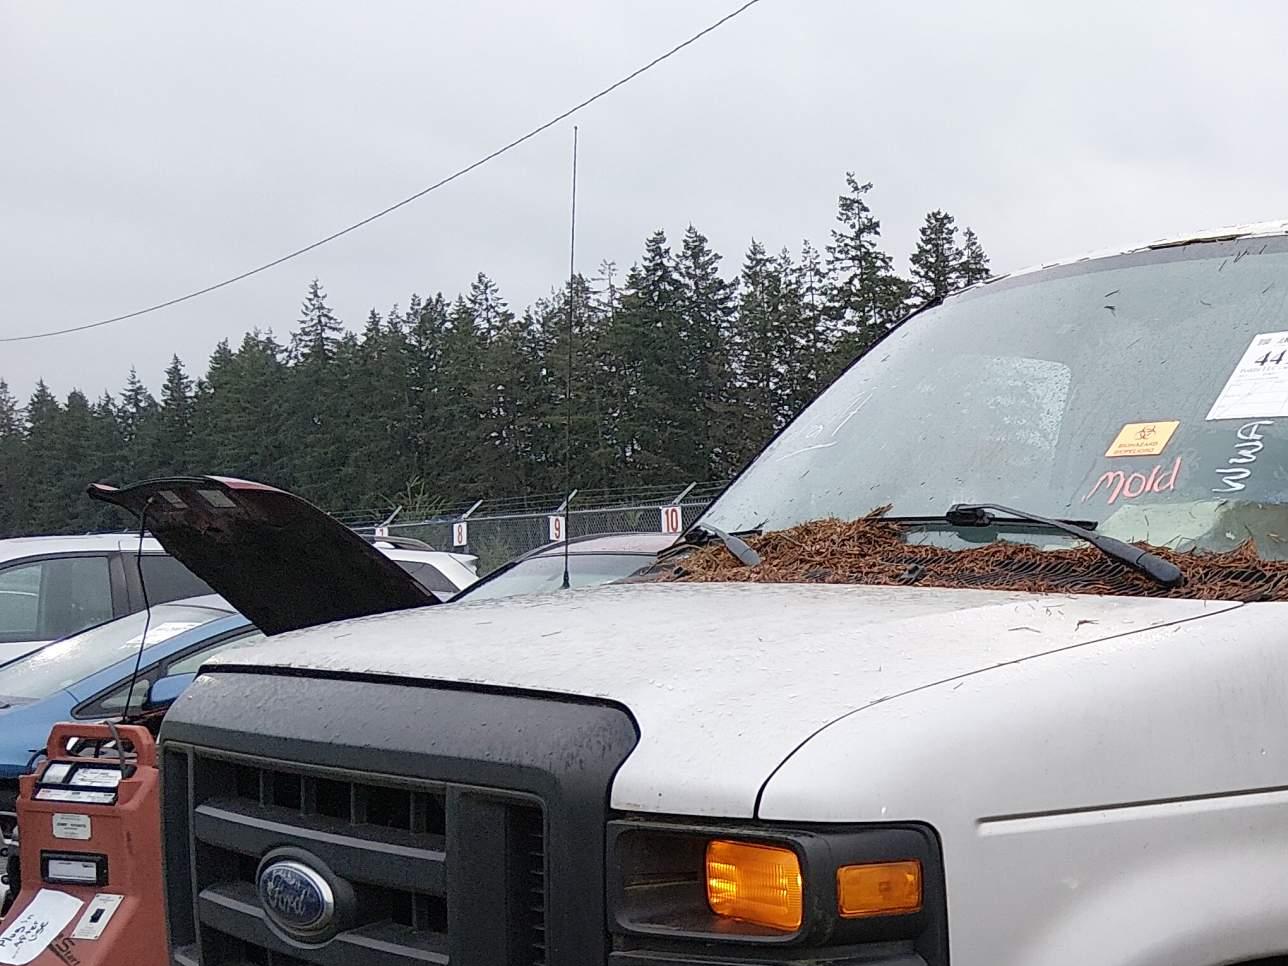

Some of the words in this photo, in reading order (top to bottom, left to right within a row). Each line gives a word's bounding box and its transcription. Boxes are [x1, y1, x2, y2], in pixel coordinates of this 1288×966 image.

[554, 518, 561, 539] 9
[665, 508, 679, 534] 10
[457, 524, 464, 544] 8
[267, 866, 306, 917] Ford
